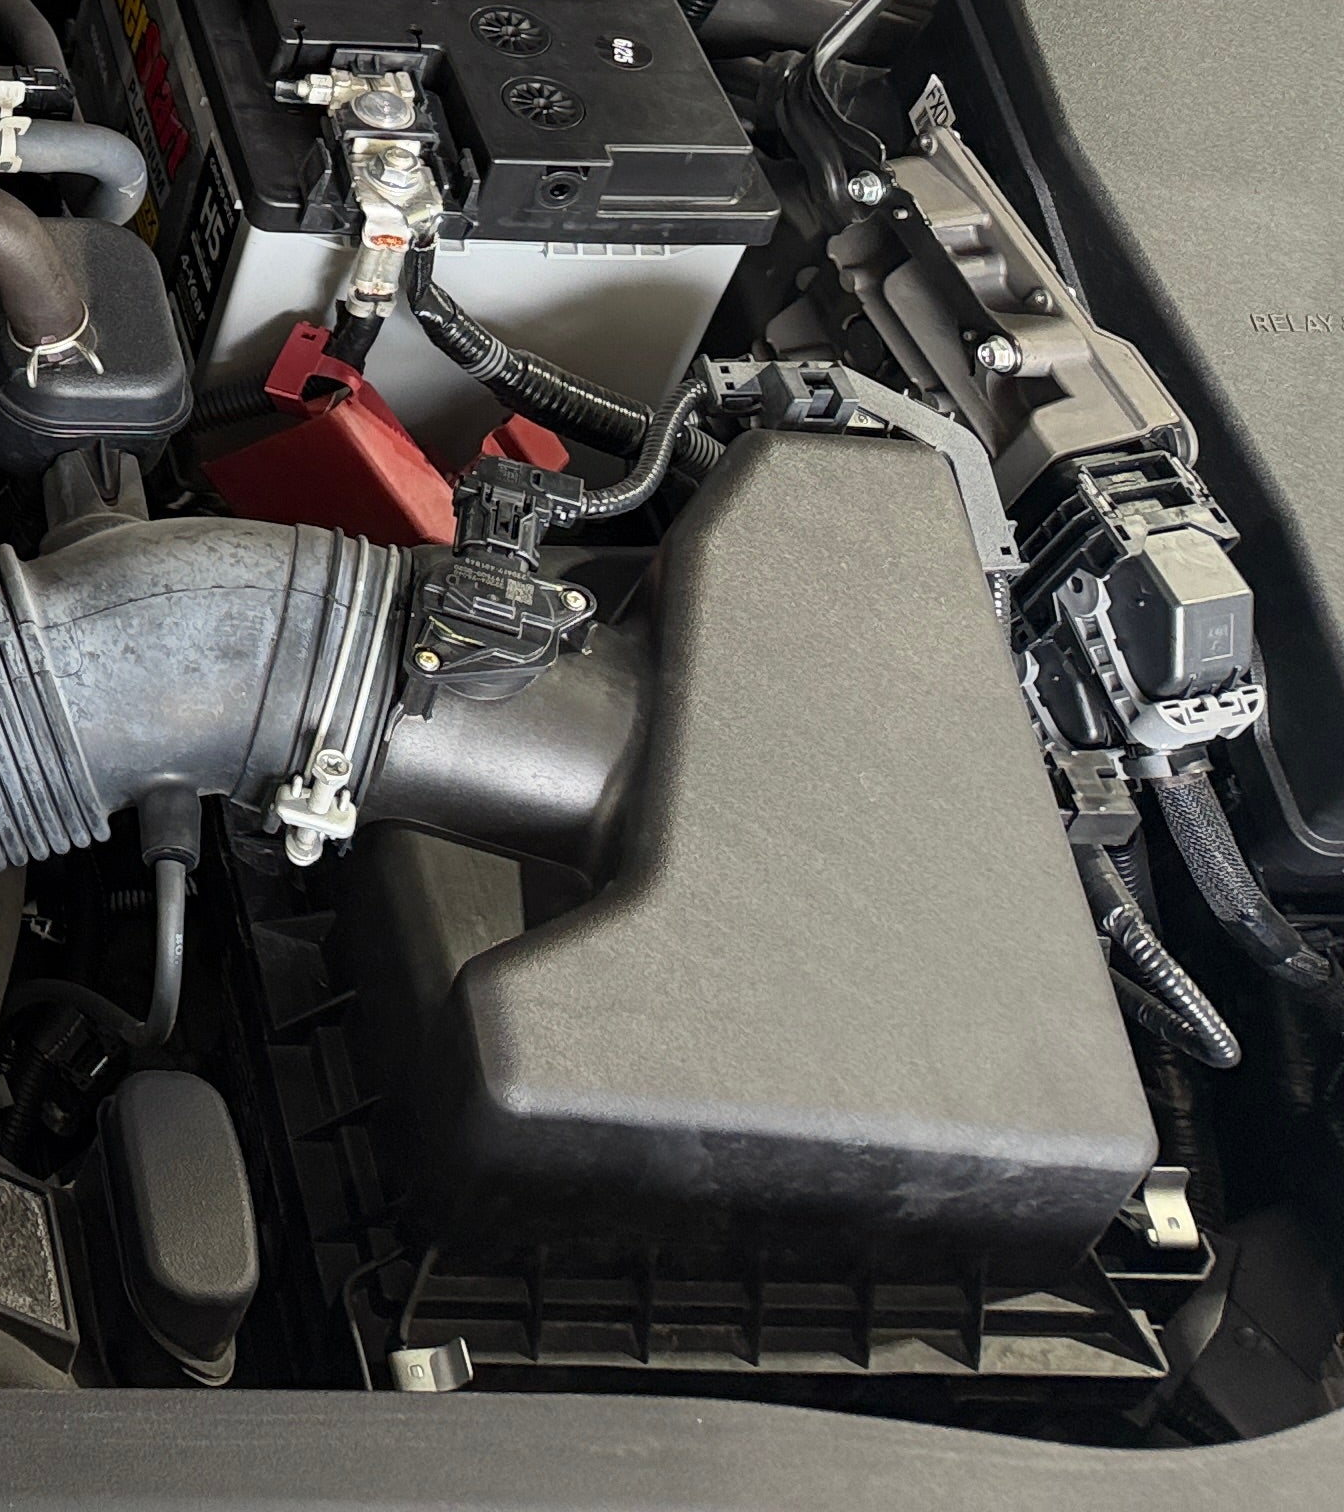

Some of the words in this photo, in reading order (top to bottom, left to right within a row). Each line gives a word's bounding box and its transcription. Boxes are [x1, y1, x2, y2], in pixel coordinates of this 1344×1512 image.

[612, 38, 634, 65] 6/25
[128, 82, 169, 196] PLATINUM
[200, 186, 225, 261] H5
[180, 255, 206, 322] 4-Year
[1249, 313, 1333, 333] RELAY
